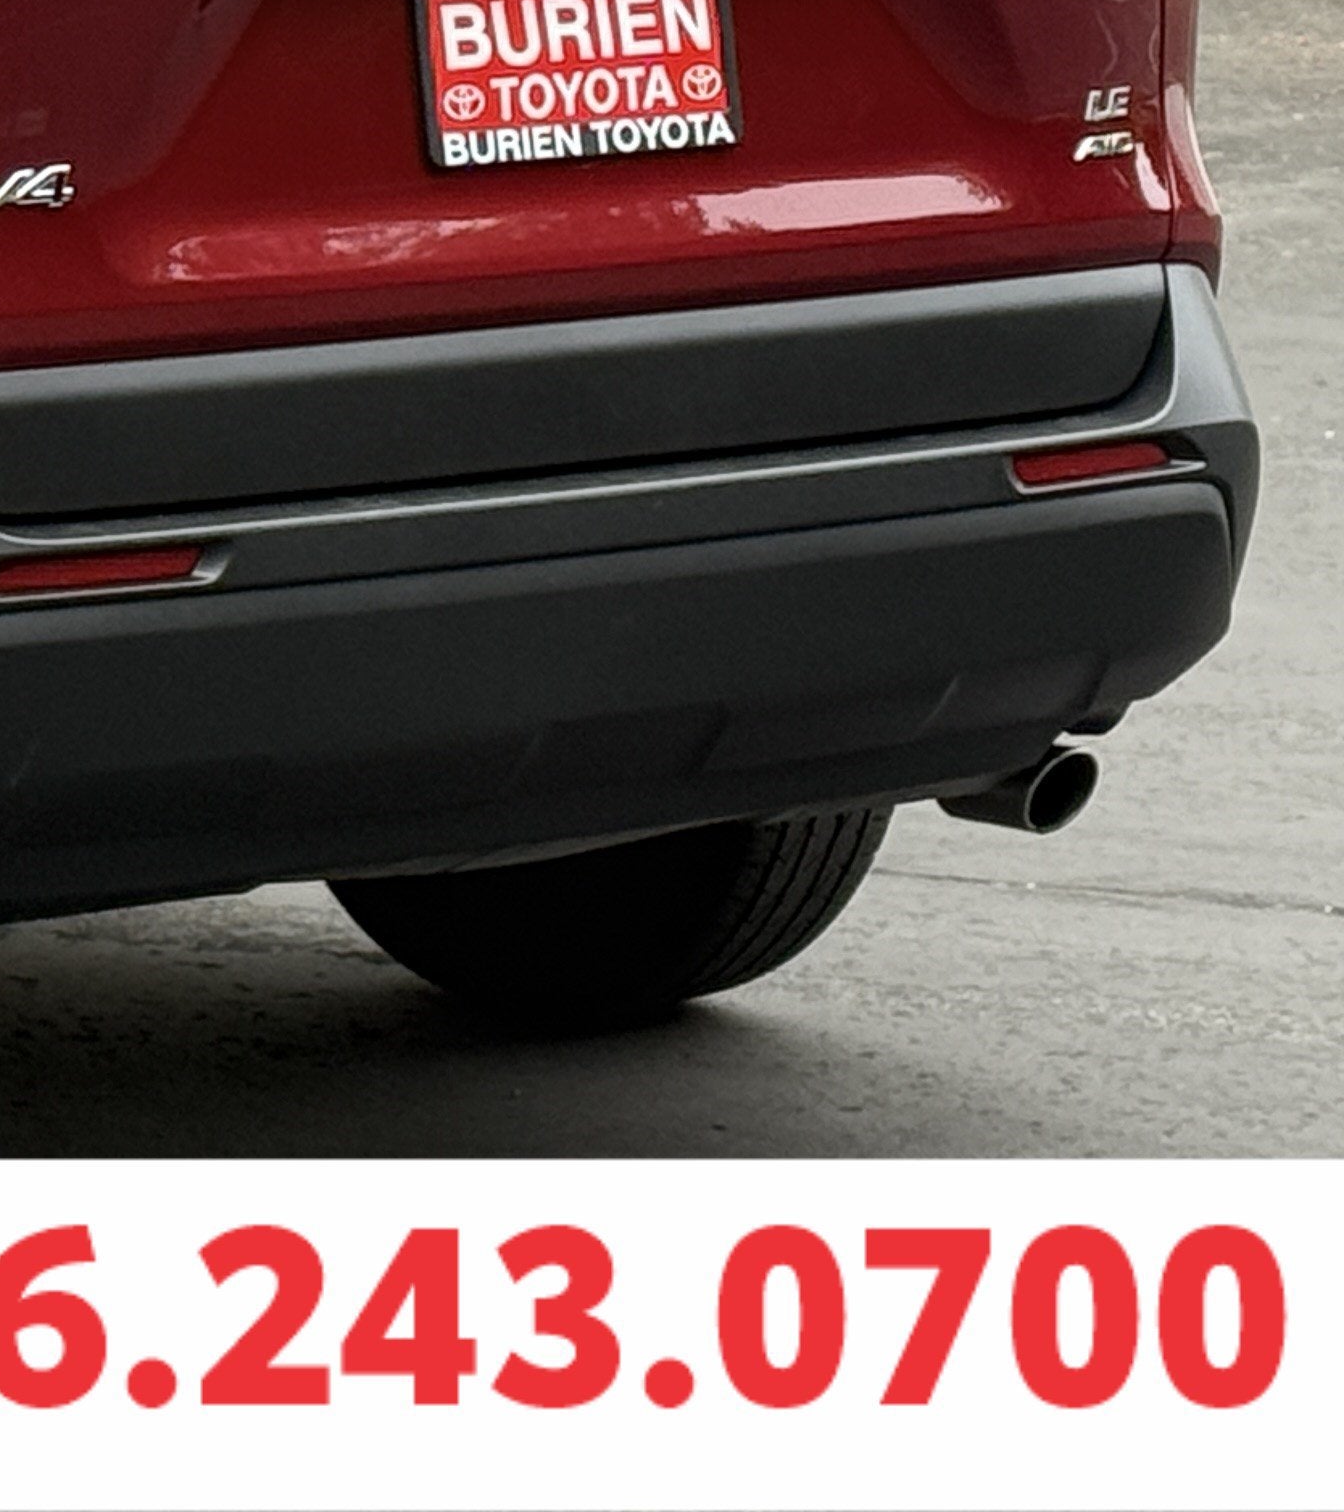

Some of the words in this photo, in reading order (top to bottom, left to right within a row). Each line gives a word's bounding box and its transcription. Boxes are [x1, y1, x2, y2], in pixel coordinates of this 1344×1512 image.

[489, 64, 680, 123] TOYOTA
[1083, 84, 1132, 122] LE
[442, 122, 584, 167] BURIEN
[589, 111, 736, 155] TOYOTA
